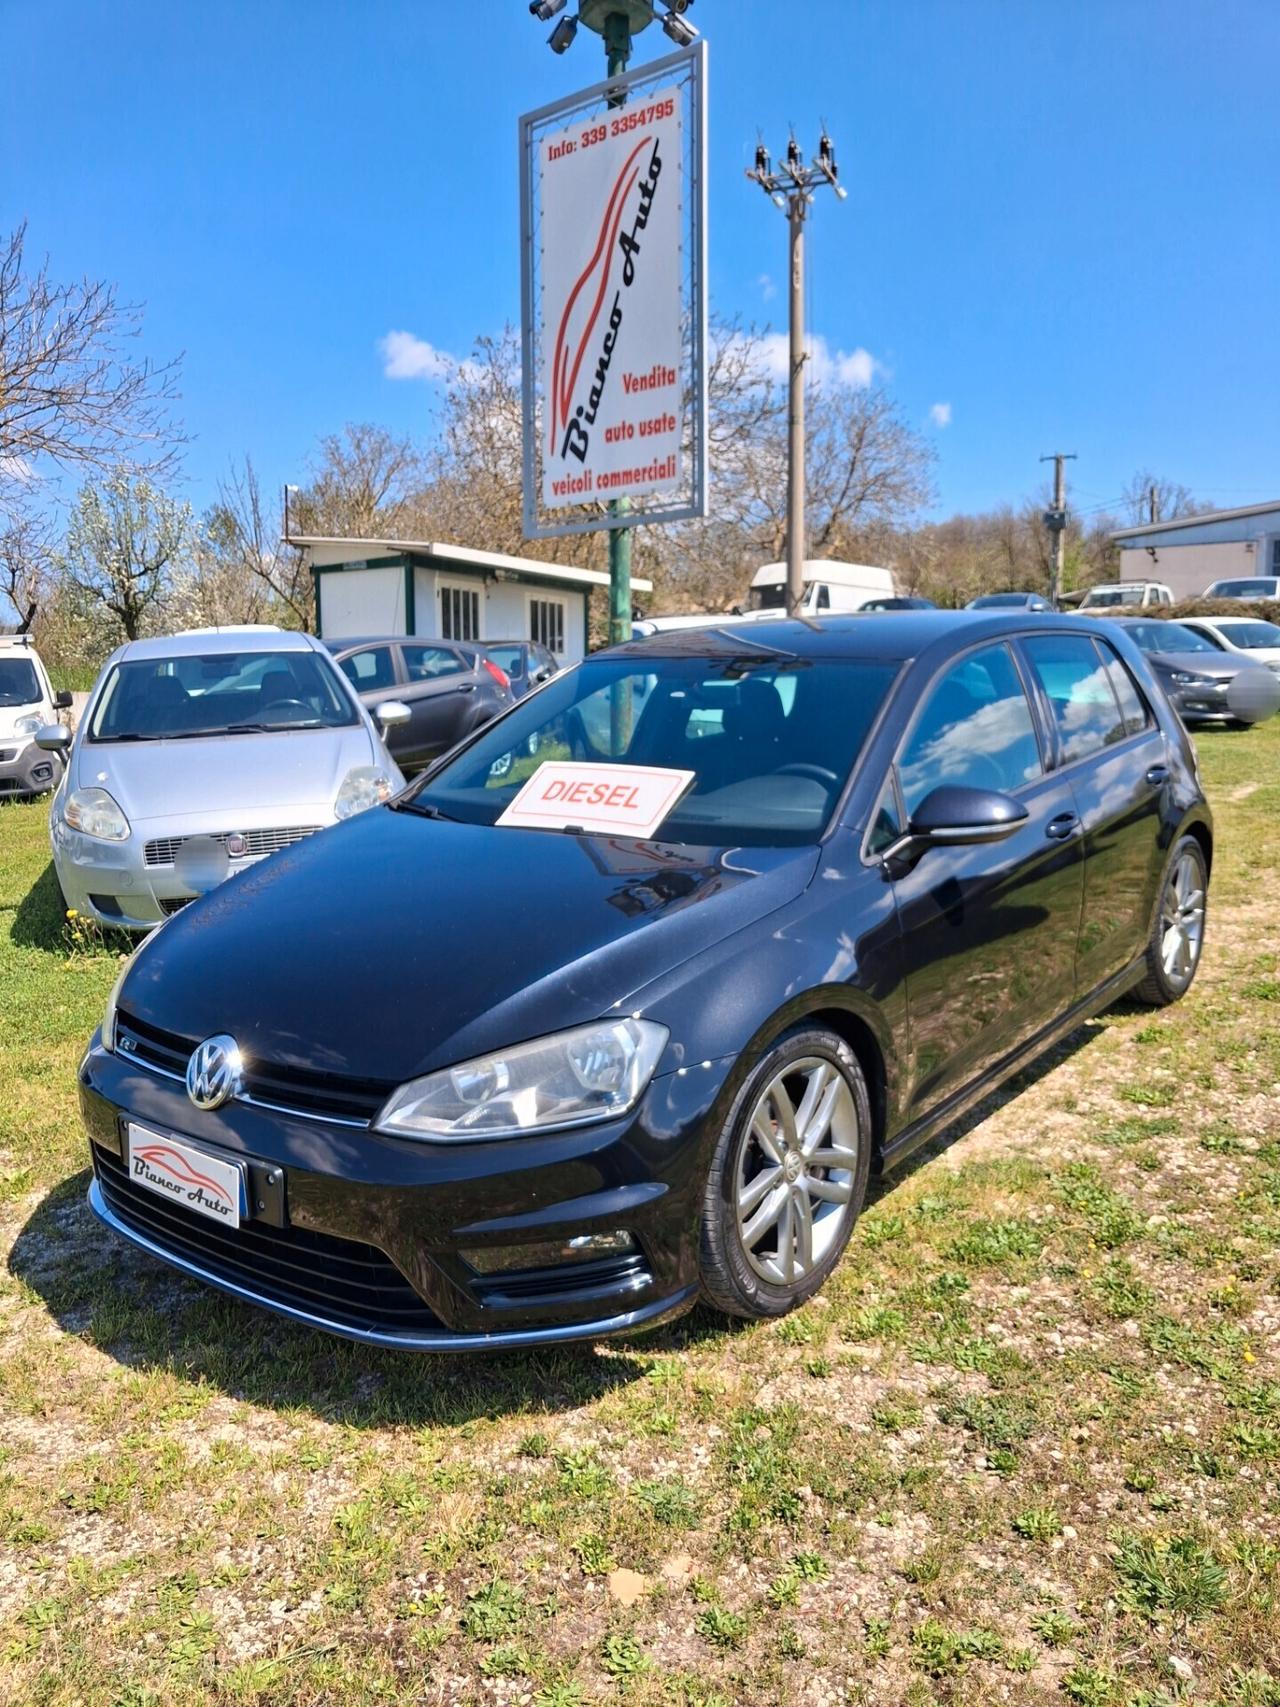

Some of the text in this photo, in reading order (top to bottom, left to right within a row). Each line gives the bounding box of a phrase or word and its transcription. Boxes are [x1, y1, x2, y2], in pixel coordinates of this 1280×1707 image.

[548, 99, 674, 161] Info: 339 3354795
[561, 138, 662, 463] Bianco Auto
[623, 365, 676, 394] Vendita
[605, 413, 676, 443] auto usate
[552, 455, 676, 496] veicoli commerciali
[541, 781, 640, 808] DIESEL
[133, 1156, 233, 1217] Bianco Auto
